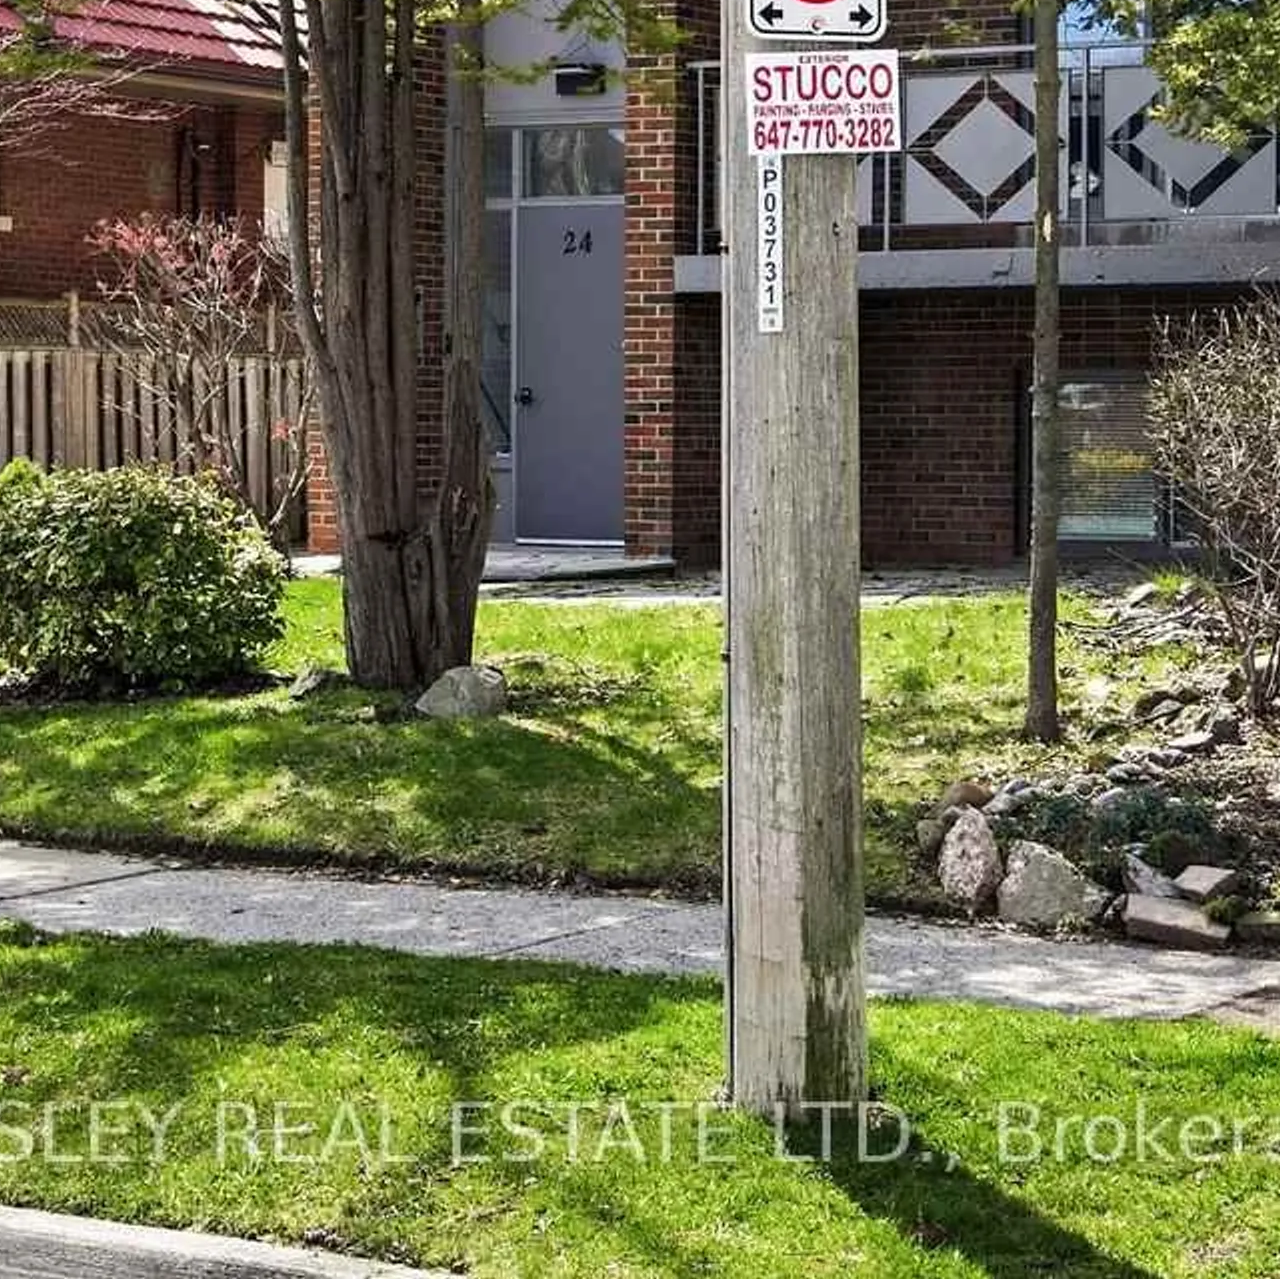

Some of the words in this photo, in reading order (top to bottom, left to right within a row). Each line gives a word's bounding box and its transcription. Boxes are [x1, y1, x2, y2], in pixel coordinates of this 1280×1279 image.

[798, 54, 850, 64] EXTERIOR
[753, 63, 893, 102] STUCCO
[563, 230, 594, 254] 24
[763, 169, 778, 304] P03731
